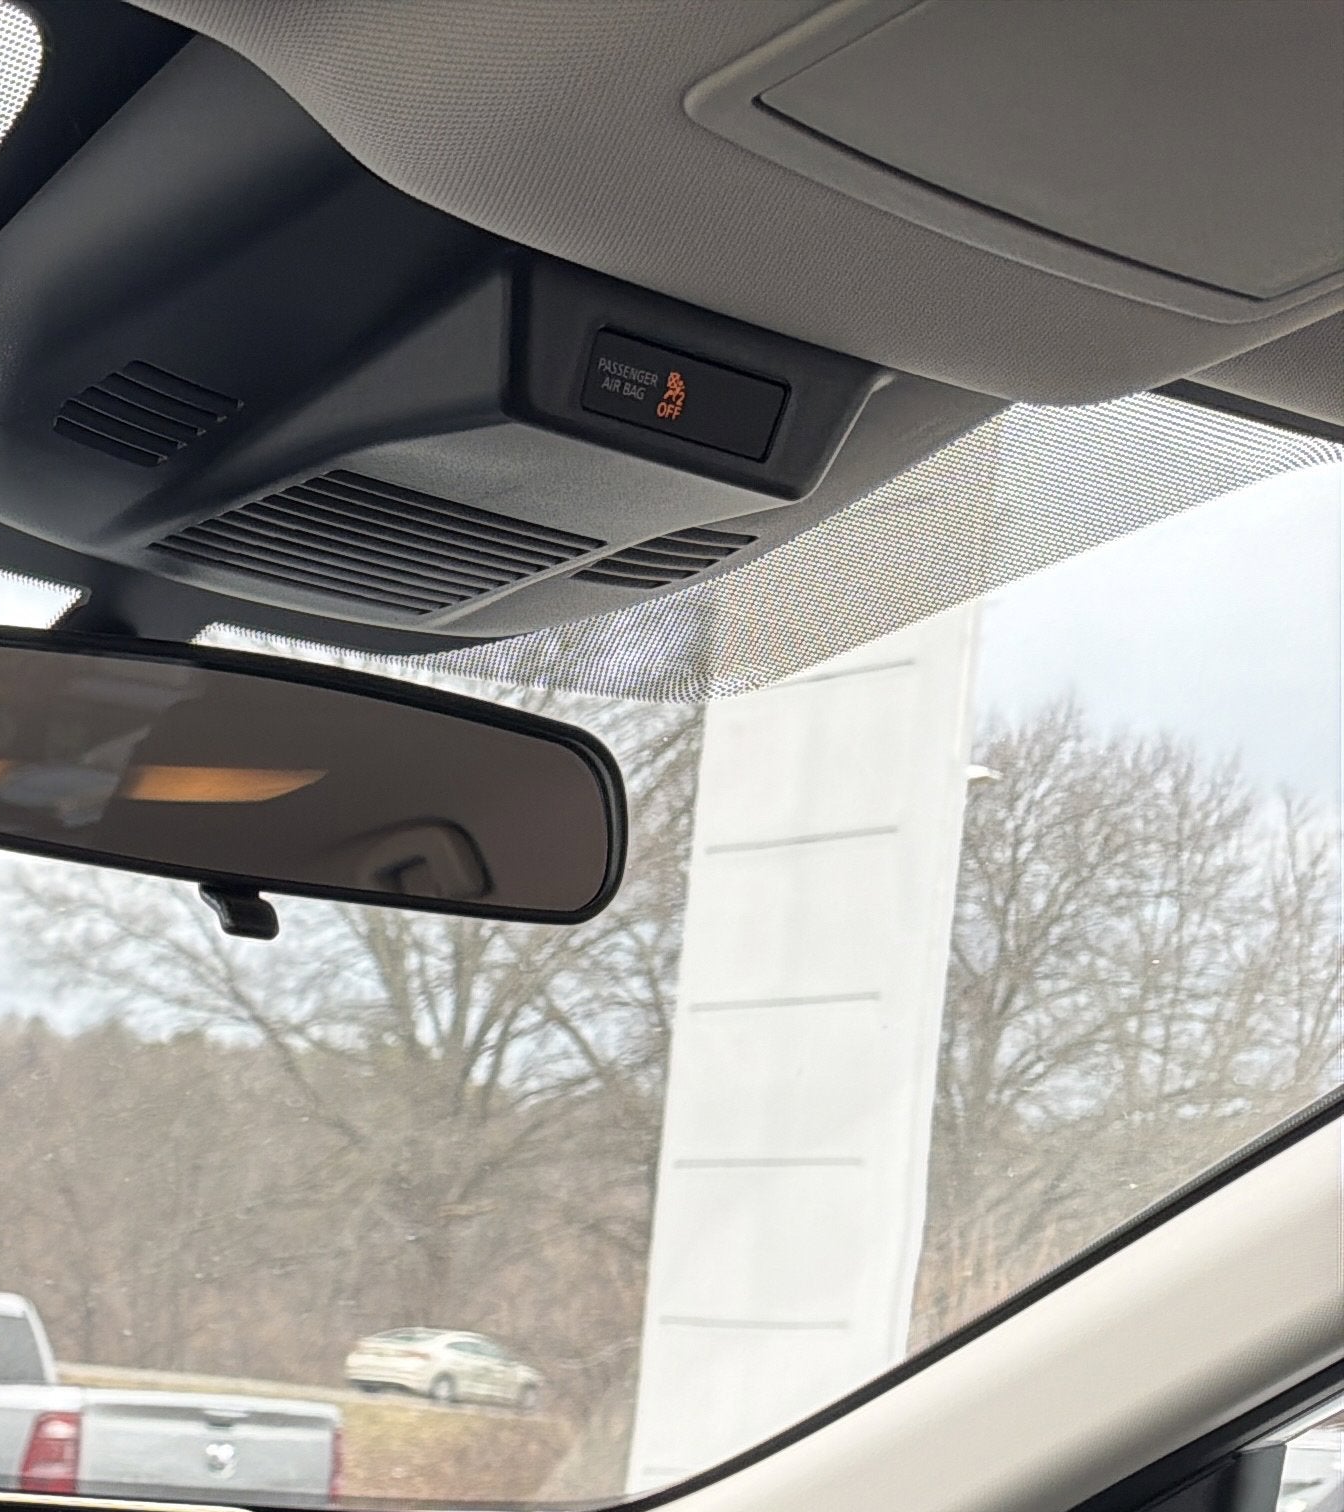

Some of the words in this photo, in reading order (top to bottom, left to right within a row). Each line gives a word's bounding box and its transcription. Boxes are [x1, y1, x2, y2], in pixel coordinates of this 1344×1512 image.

[597, 357, 659, 388] PASSENGER
[601, 376, 621, 393] AIR
[622, 381, 646, 400] BAG
[656, 401, 683, 420] OFF
